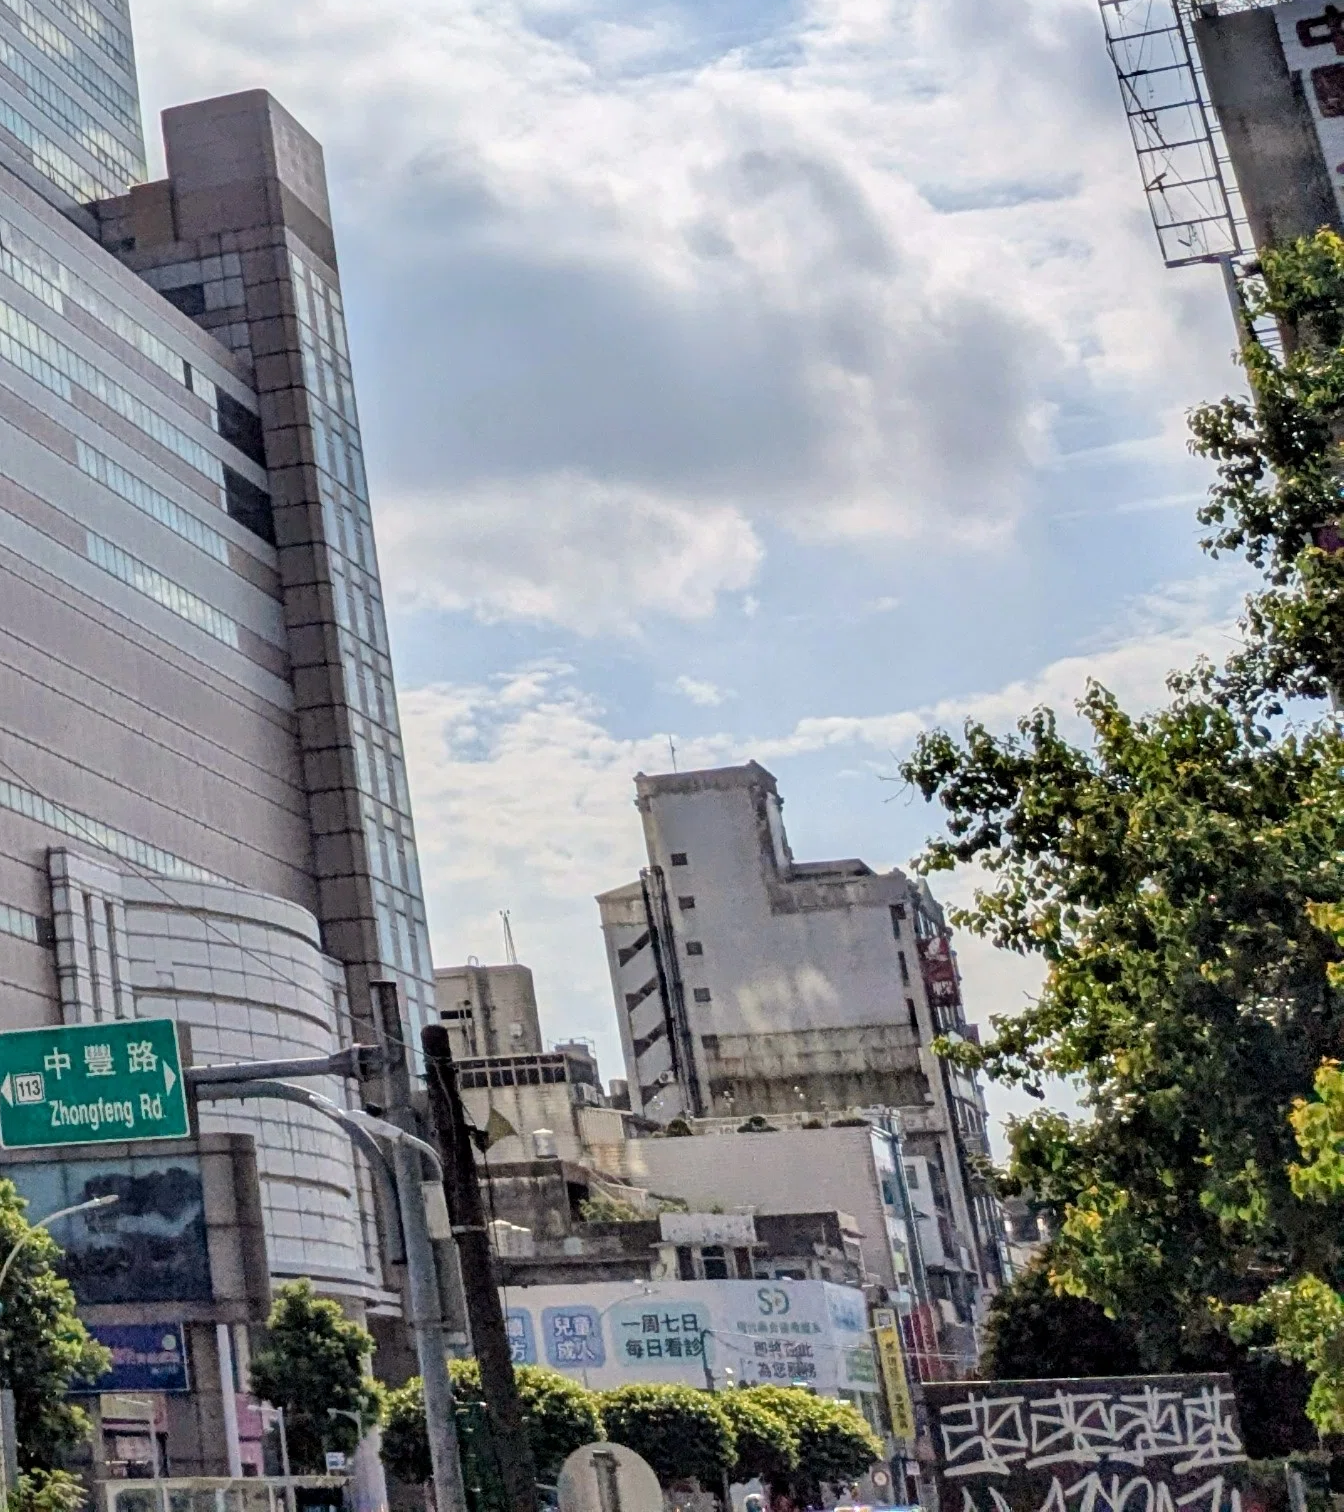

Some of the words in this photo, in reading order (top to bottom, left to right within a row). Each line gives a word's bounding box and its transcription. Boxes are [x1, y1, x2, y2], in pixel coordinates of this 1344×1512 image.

[43, 1040, 159, 1080] 中豐路
[18, 1080, 41, 1098] 113
[49, 1096, 134, 1131] Zhongfeng
[553, 1314, 592, 1337] 兒童
[621, 1313, 699, 1334] 一周七日
[556, 1341, 595, 1361] 成人
[625, 1338, 705, 1359] 每日看診
